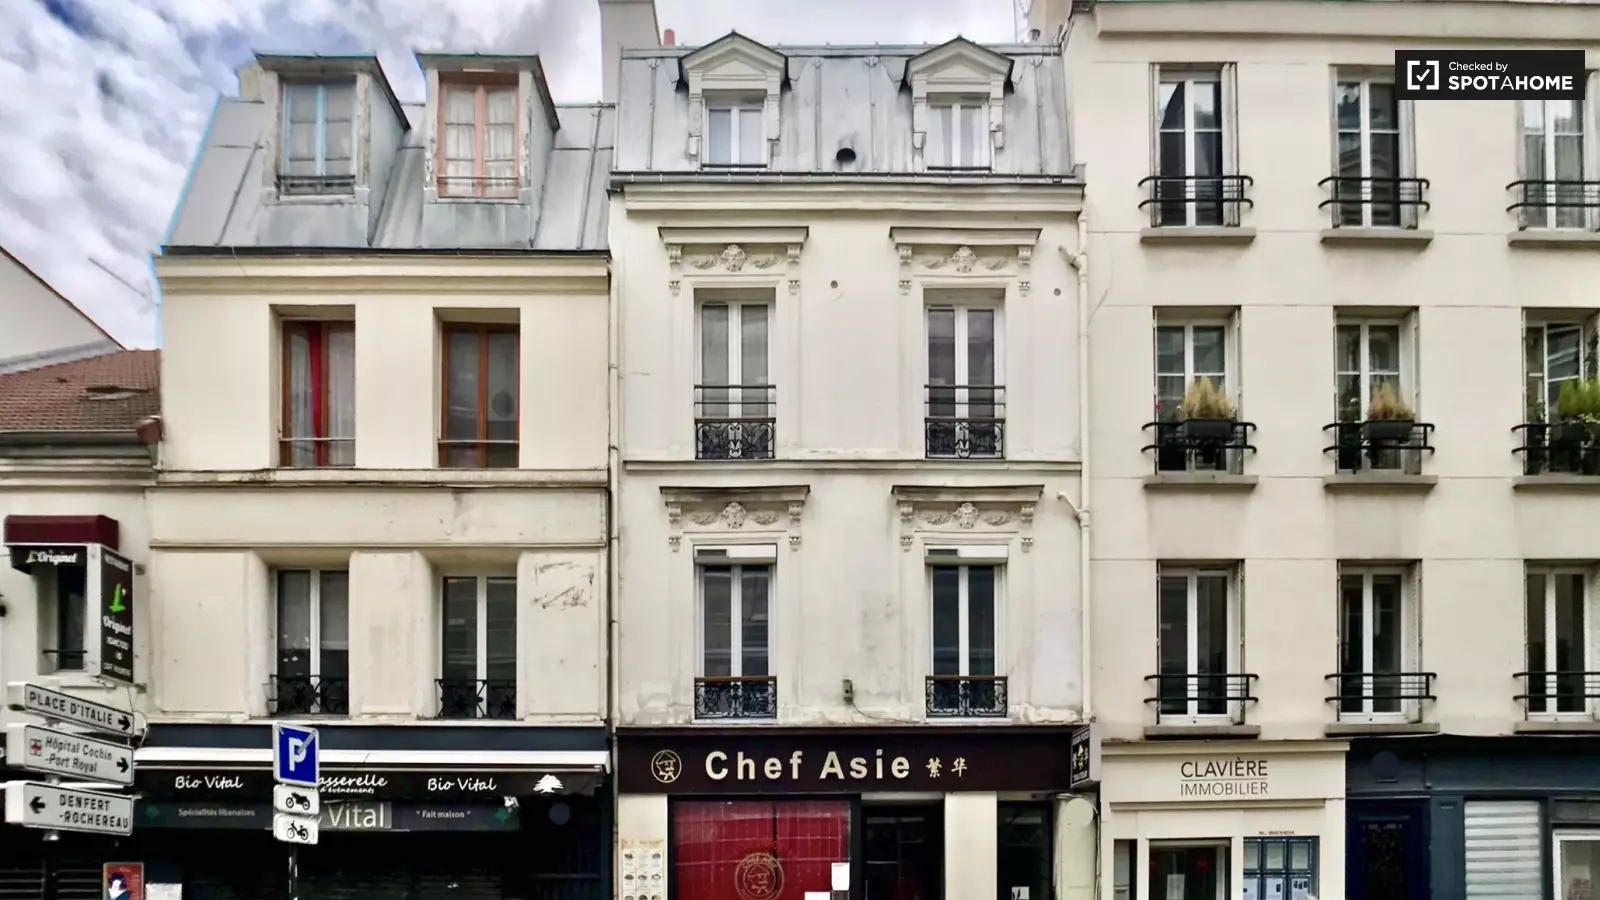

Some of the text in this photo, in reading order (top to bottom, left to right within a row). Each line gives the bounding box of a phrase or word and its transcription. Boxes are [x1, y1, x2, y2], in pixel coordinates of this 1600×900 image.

[29, 691, 113, 725] PLACE D'ITALIE
[45, 736, 112, 760] Hôpital Cochin
[288, 737, 307, 772] P
[73, 758, 98, 773] Royal
[705, 749, 911, 780] Chef Asie
[1181, 756, 1269, 778] CLAVIÈRE
[175, 775, 244, 789] Bio Vital
[318, 774, 388, 787] asserelle
[427, 777, 497, 791] Bio Vital
[1180, 782, 1269, 796] IMMOBILIER
[59, 794, 111, 812] DENFERT
[59, 810, 129, 829] -ROCHEREAU
[328, 802, 385, 827] Vital
